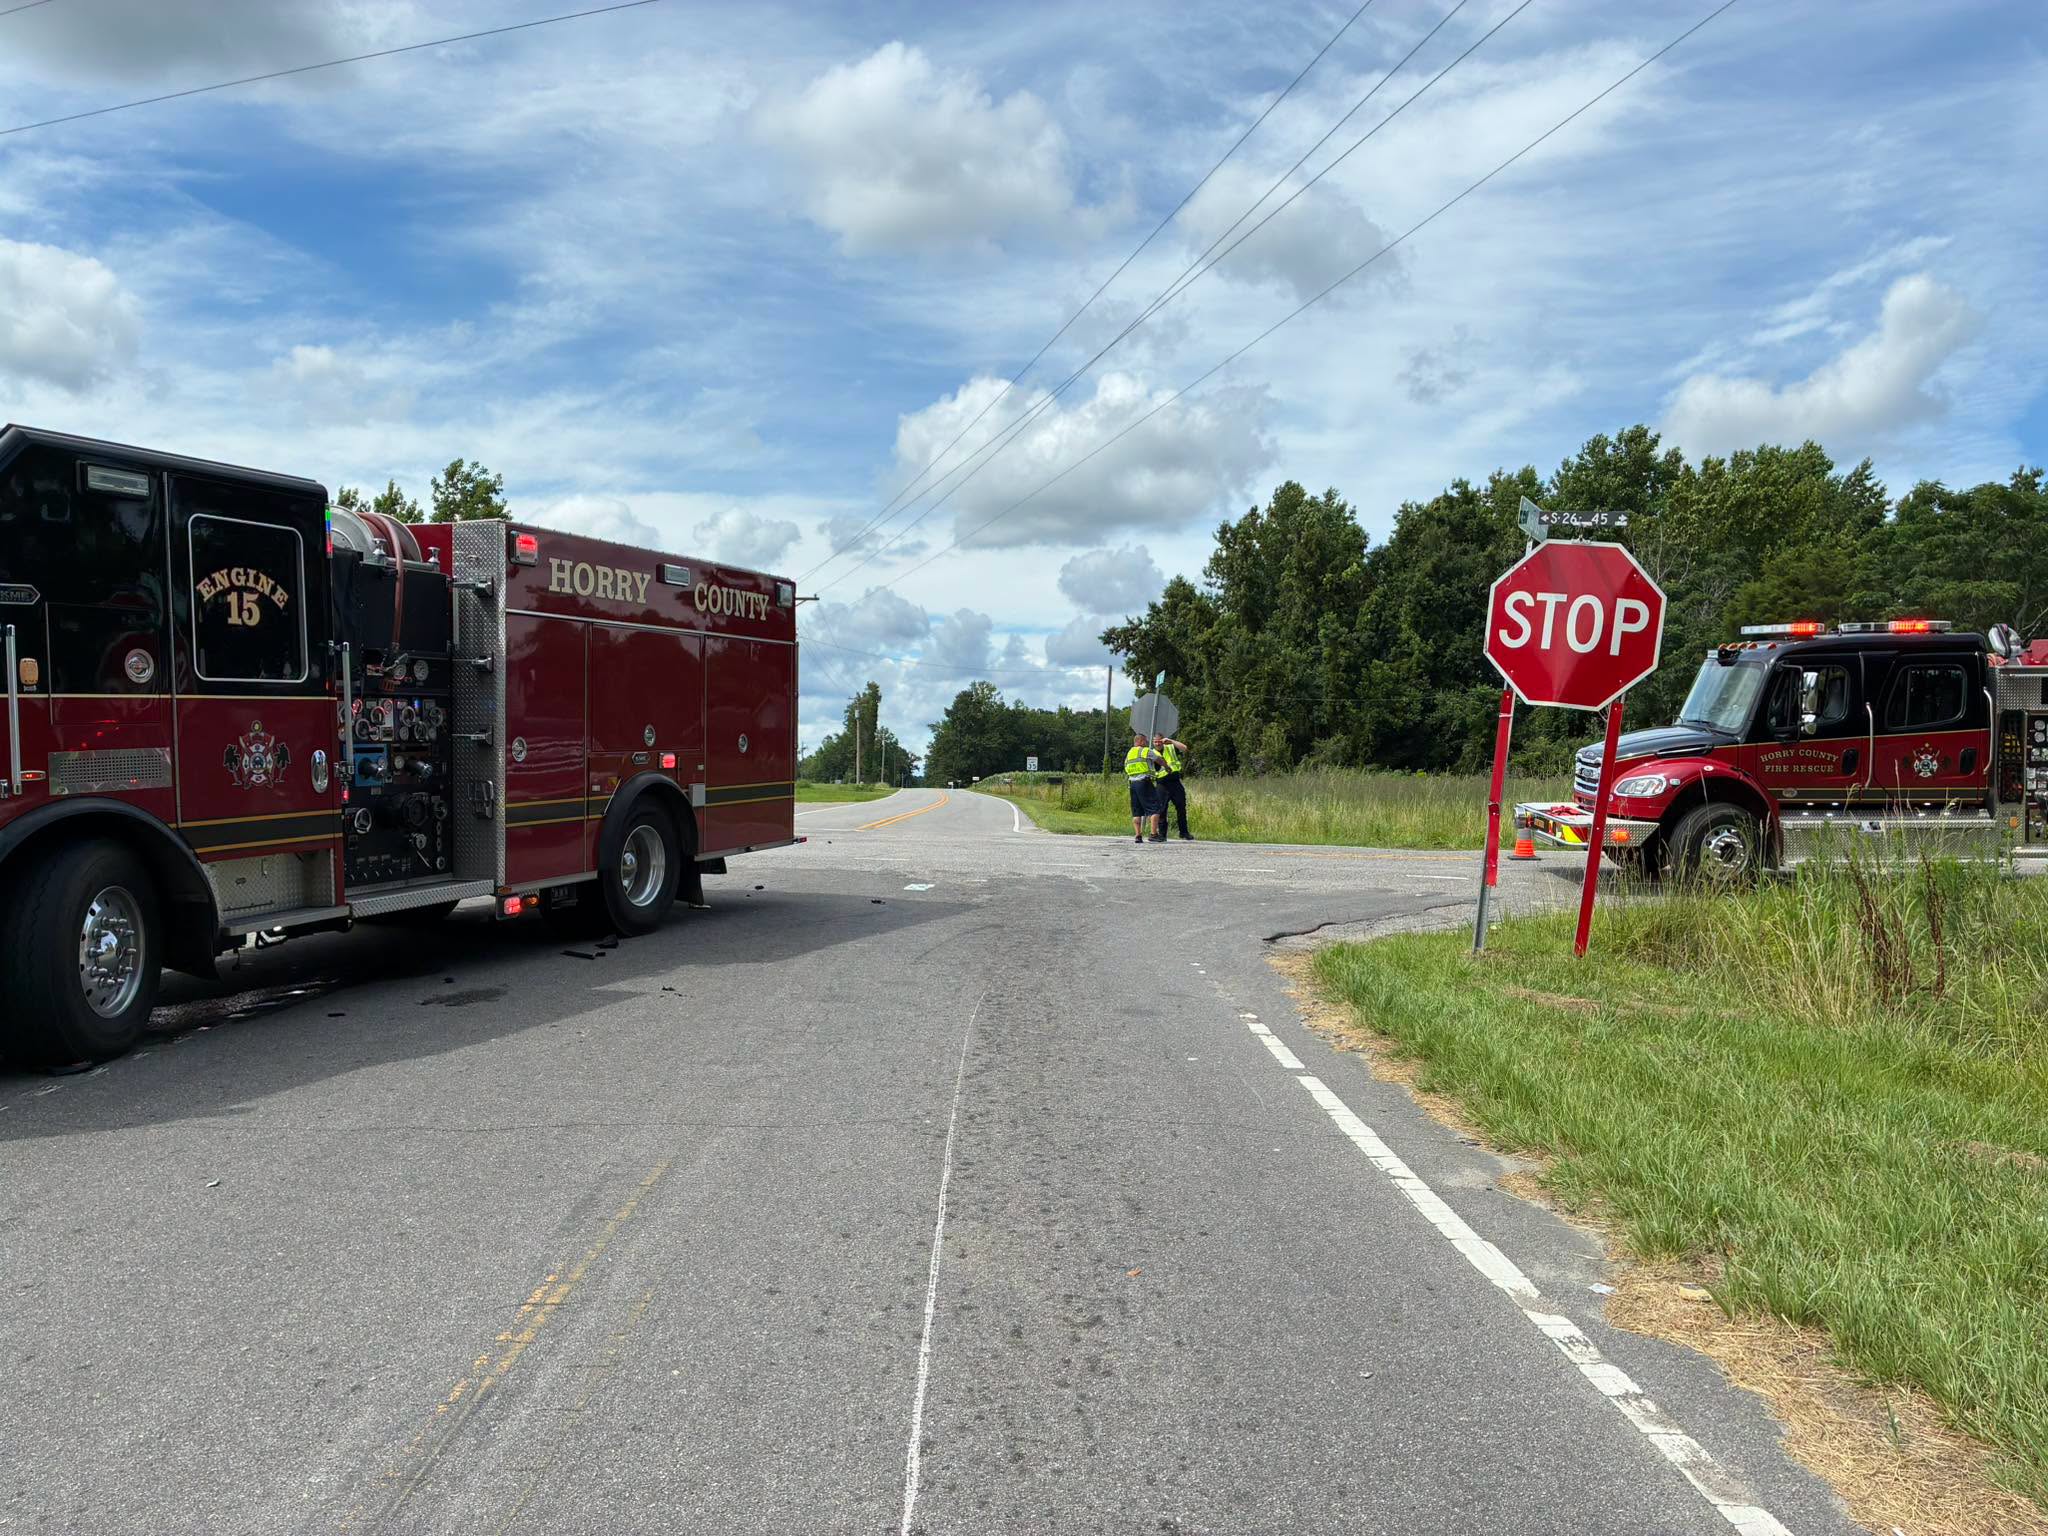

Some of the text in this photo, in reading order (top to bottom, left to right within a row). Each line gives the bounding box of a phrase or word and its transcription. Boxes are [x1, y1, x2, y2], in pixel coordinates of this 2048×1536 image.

[196, 567, 289, 610] ENGINE
[227, 591, 260, 626] 15
[549, 558, 770, 621] HORRY COUNTY
[1499, 591, 1650, 656] STOP
[1760, 749, 1839, 762] HORRY COUNTY
